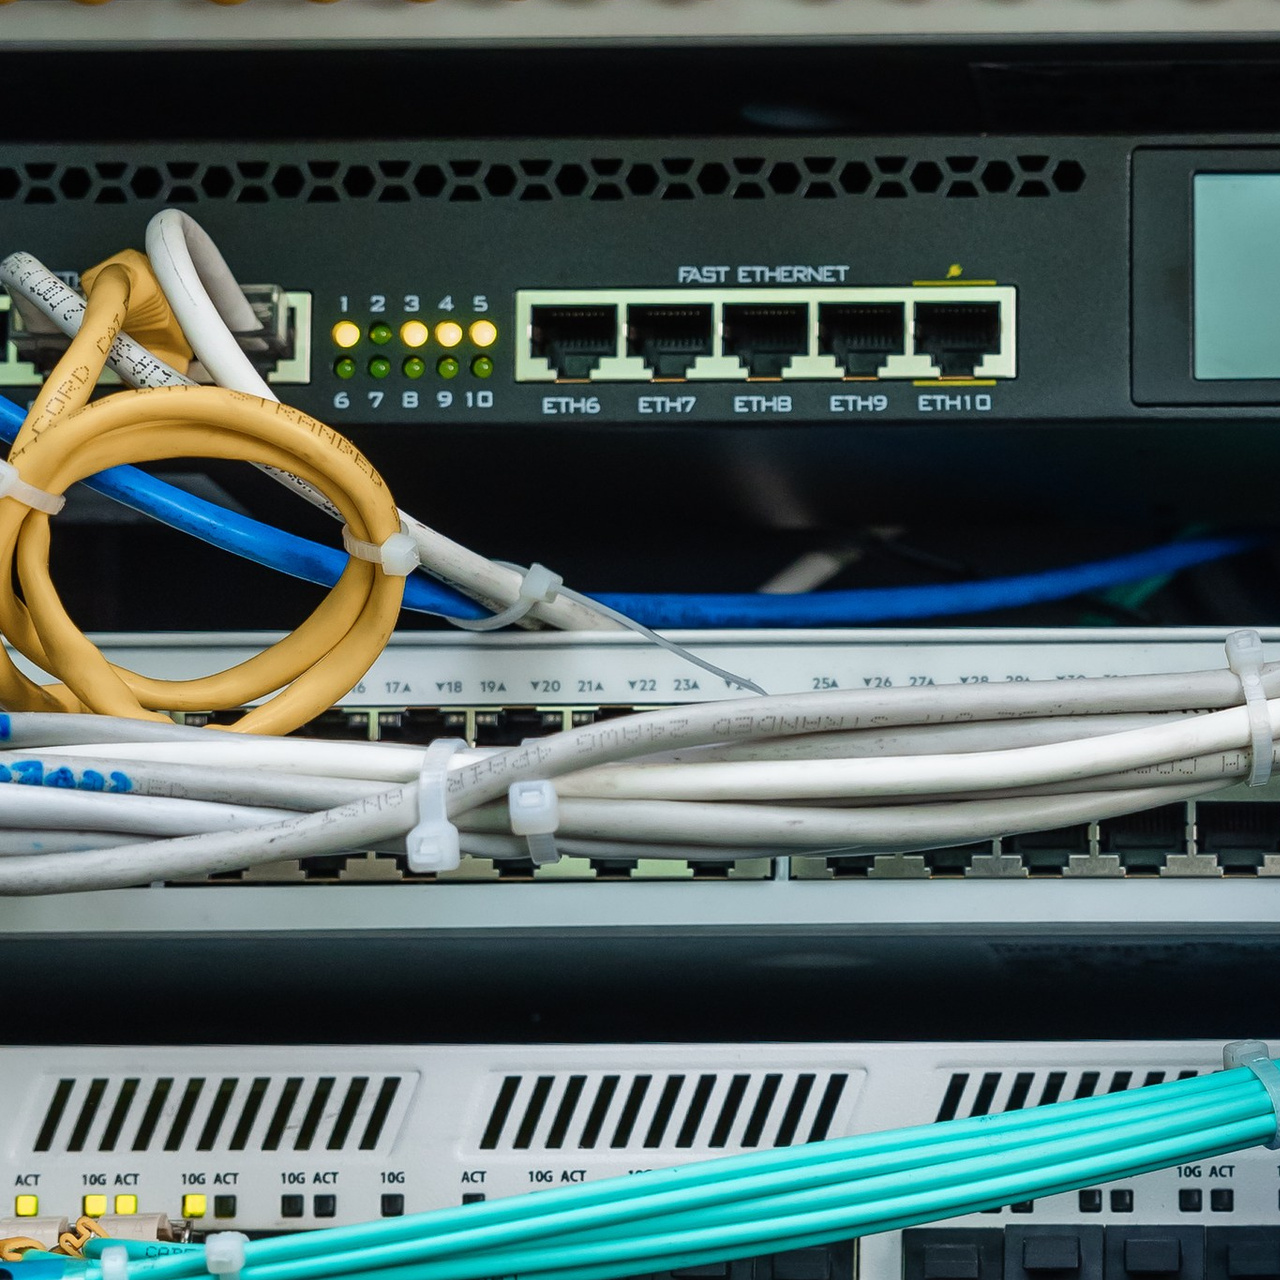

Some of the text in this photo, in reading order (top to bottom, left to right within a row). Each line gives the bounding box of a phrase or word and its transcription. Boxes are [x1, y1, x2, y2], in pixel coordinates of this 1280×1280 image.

[678, 264, 850, 283] FAST ETHERNET
[340, 295, 489, 313] 1 2 3 4 5
[31, 364, 91, 437] CORD
[334, 390, 494, 409] 6 7 8 9 10
[542, 396, 600, 414] ETH6
[638, 396, 696, 414] ETH7
[734, 396, 792, 413] ETH8
[830, 395, 888, 413] ETH9
[918, 394, 991, 412] ETH10
[385, 681, 401, 695] 17
[446, 680, 462, 694] 18
[480, 680, 496, 694] 19
[540, 679, 561, 693] 20
[578, 680, 595, 693] 21
[638, 679, 657, 693] 22
[674, 679, 691, 692] 23
[812, 676, 831, 690] 25
[874, 676, 892, 689] 26
[909, 676, 927, 688] 27
[446, 744, 554, 793] 4PAIR
[313, 1171, 339, 1185] ACT
[380, 1171, 405, 1185] 10G
[461, 1170, 487, 1184] ACT
[528, 1170, 554, 1184] 10G
[561, 1169, 587, 1183] ACT
[1177, 1164, 1202, 1178] 10G
[1209, 1164, 1235, 1178] ACT
[15, 1174, 41, 1187] ACT
[82, 1173, 107, 1187] 10G
[114, 1173, 140, 1186] ACT
[181, 1173, 206, 1186] 10G
[213, 1172, 239, 1186] ACT
[281, 1172, 306, 1185] 10G
